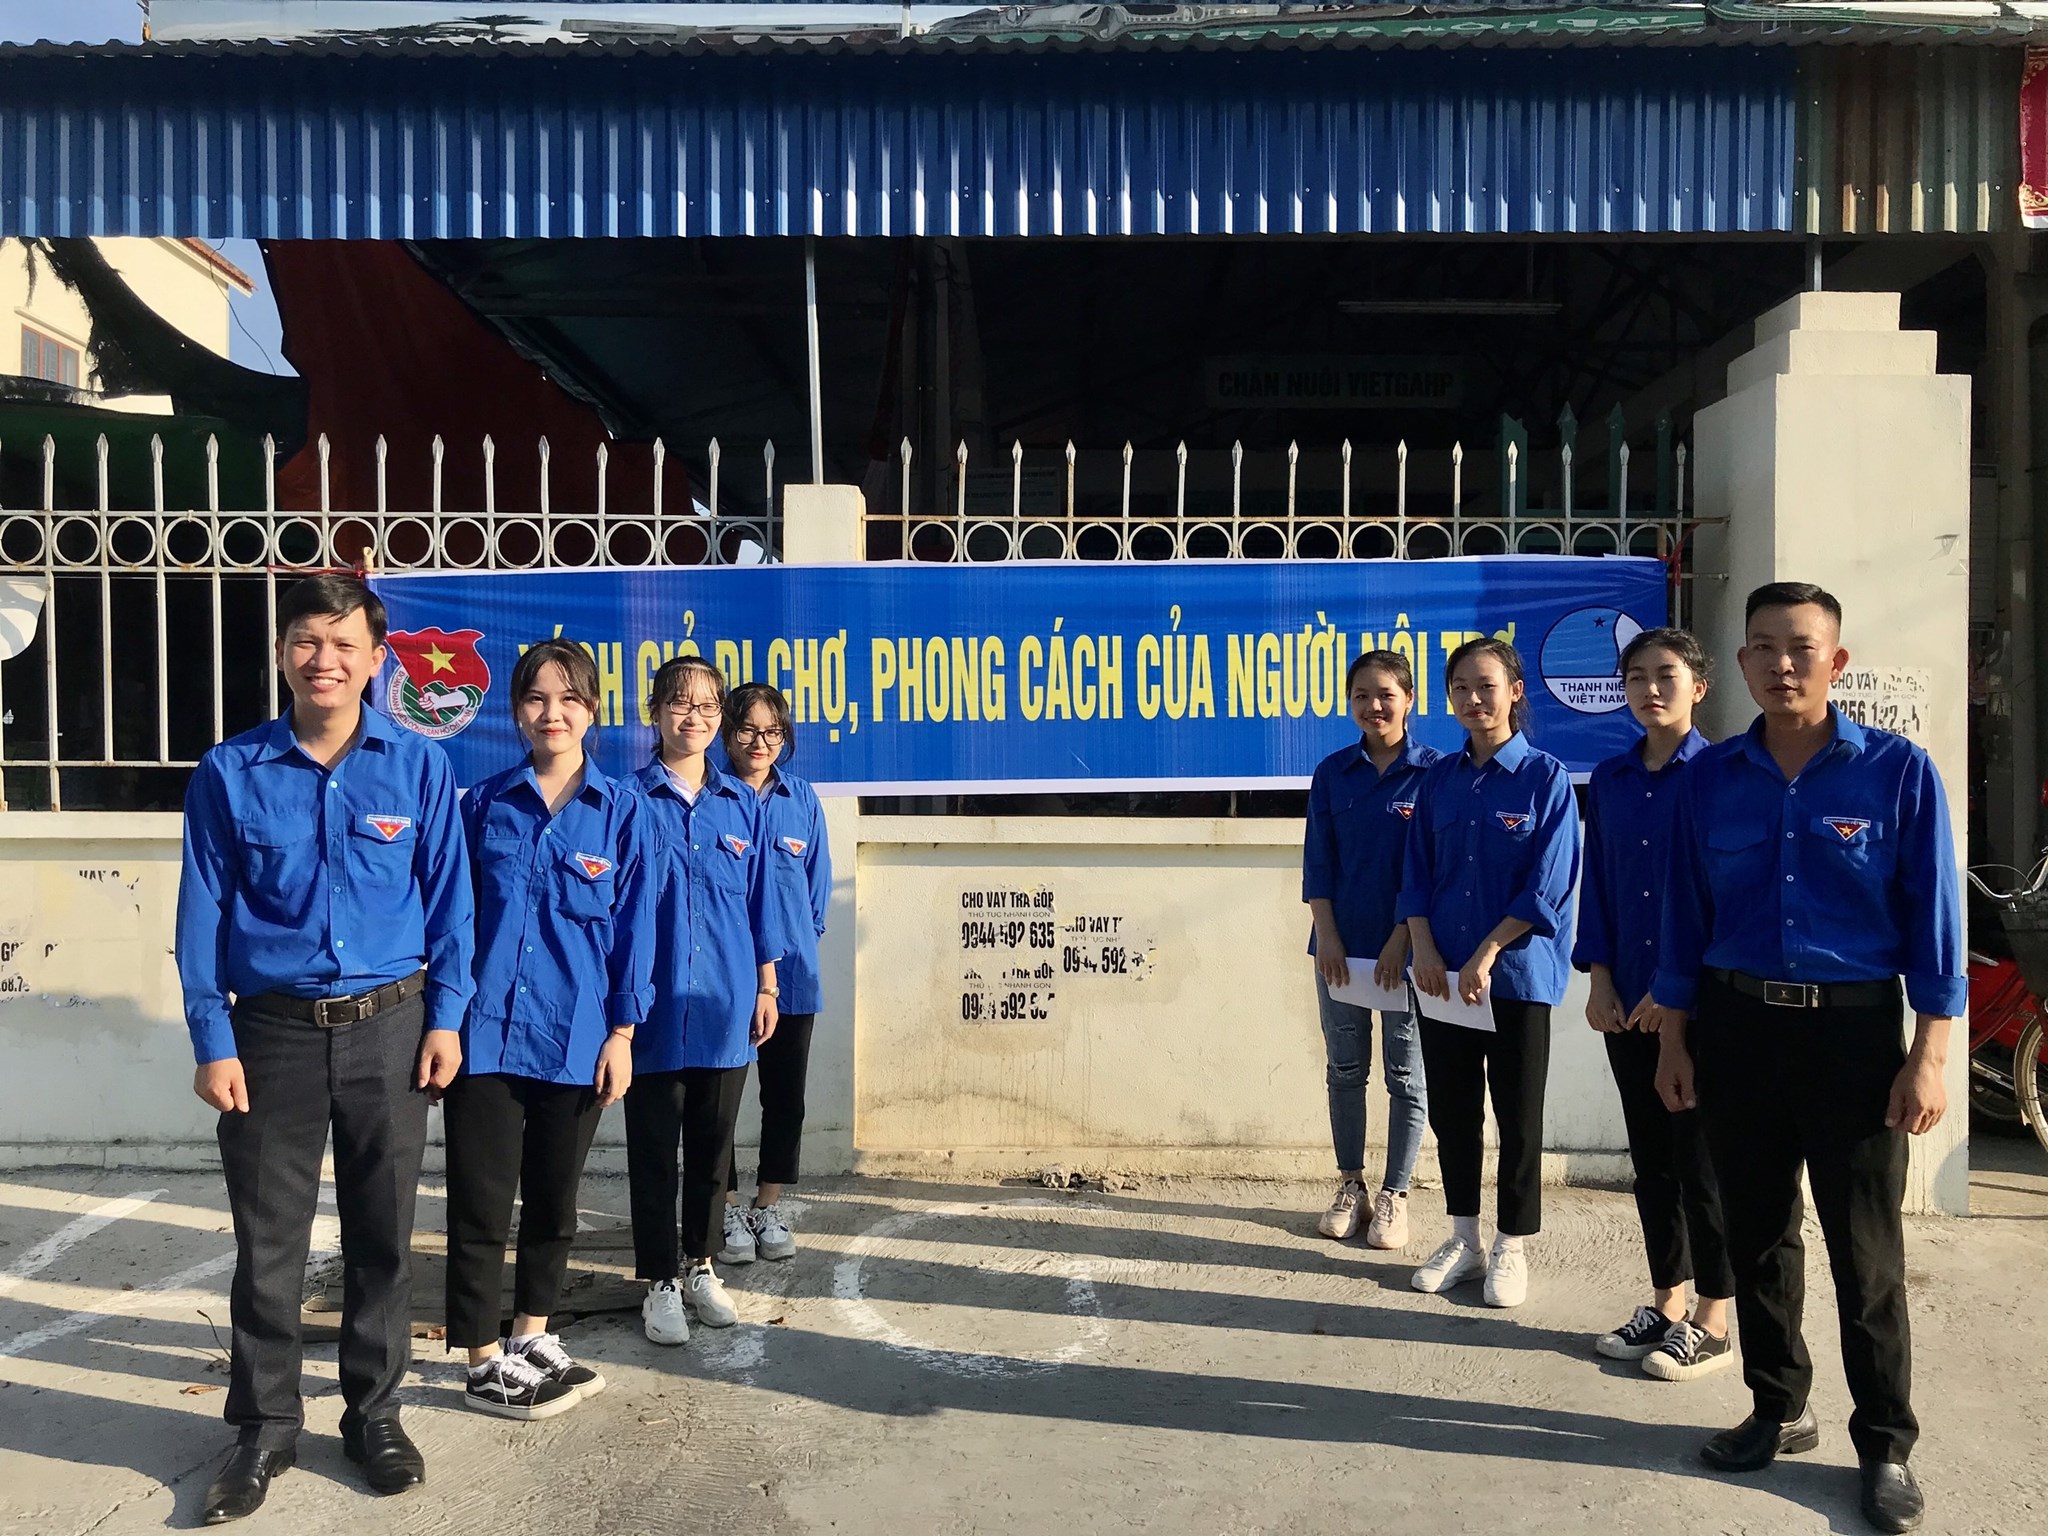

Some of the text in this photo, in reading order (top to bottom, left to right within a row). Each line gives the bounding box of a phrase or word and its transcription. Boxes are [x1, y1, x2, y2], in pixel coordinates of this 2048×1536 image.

[767, 628, 859, 743] CHỢ,
[871, 635, 1007, 723] PHONG
[1019, 616, 1123, 722] CÁCH
[1136, 604, 1216, 720] CỦA
[1227, 610, 1348, 719] NGƯỜI
[1560, 680, 1626, 692] THANH NIÊ
[1568, 692, 1626, 705] VIỆT NAM
[962, 891, 984, 909] CHO
[986, 891, 1007, 908] VAY
[1029, 921, 1055, 949] 635
[1101, 946, 1128, 974] 592
